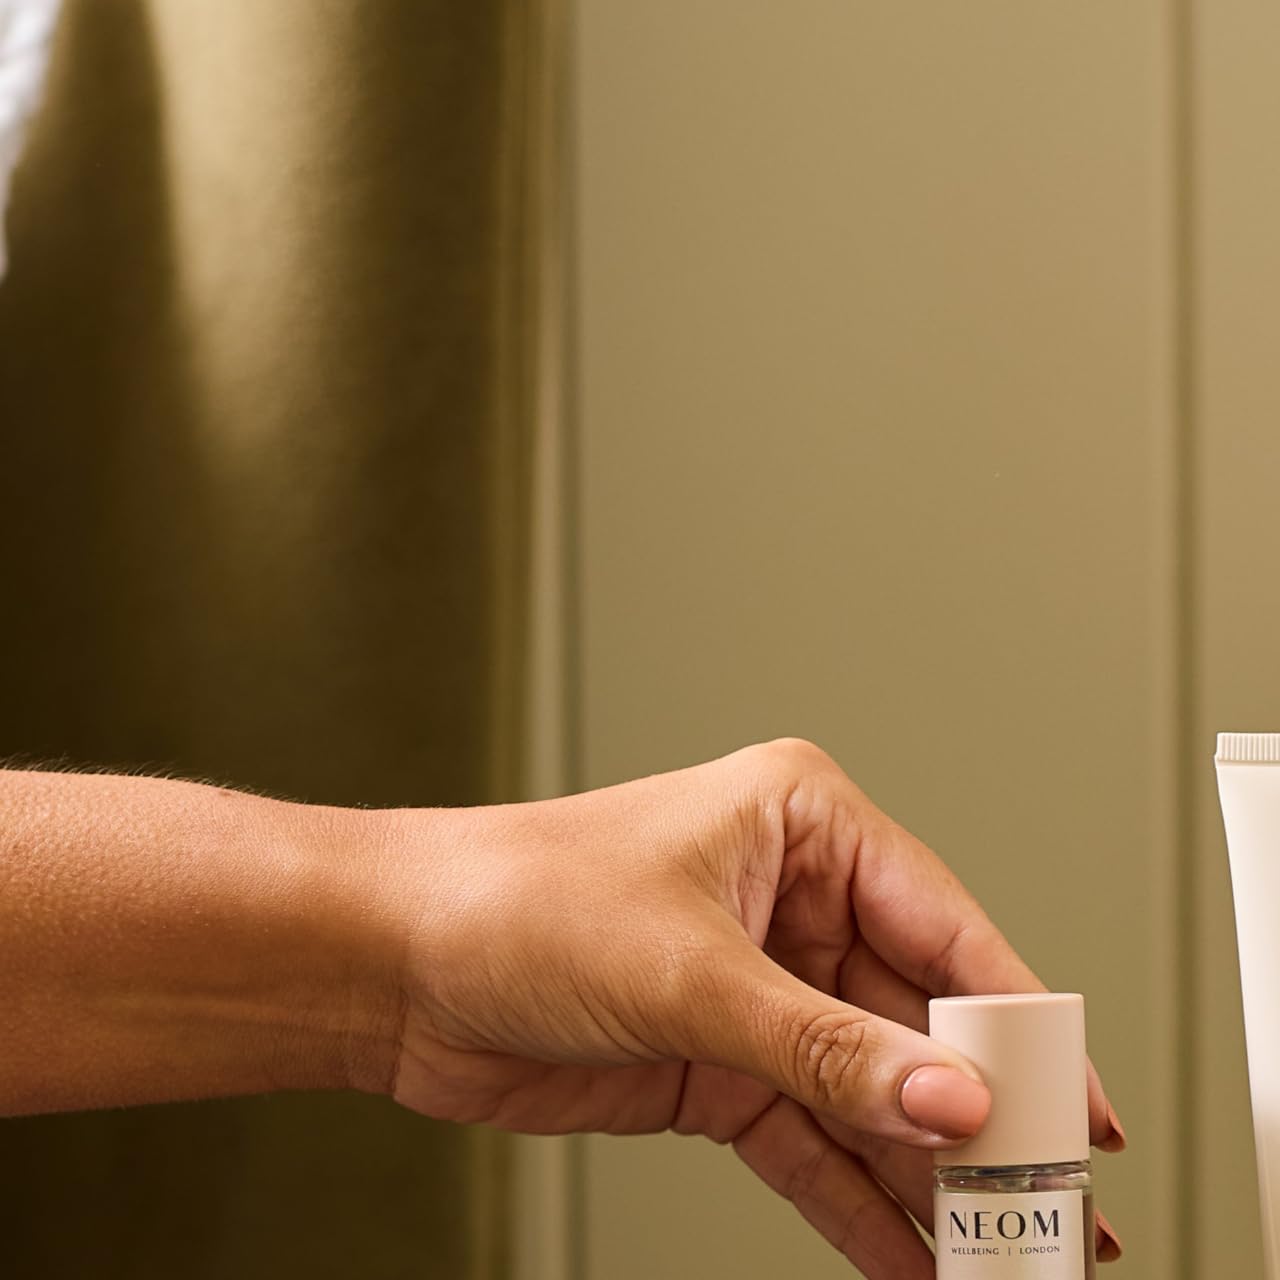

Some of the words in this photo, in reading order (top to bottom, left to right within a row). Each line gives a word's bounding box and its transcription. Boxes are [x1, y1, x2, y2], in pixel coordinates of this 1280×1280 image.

[950, 1209, 1060, 1240] NEOM
[951, 1247, 1000, 1256] WELLBEING
[1019, 1245, 1061, 1255] LONDON
